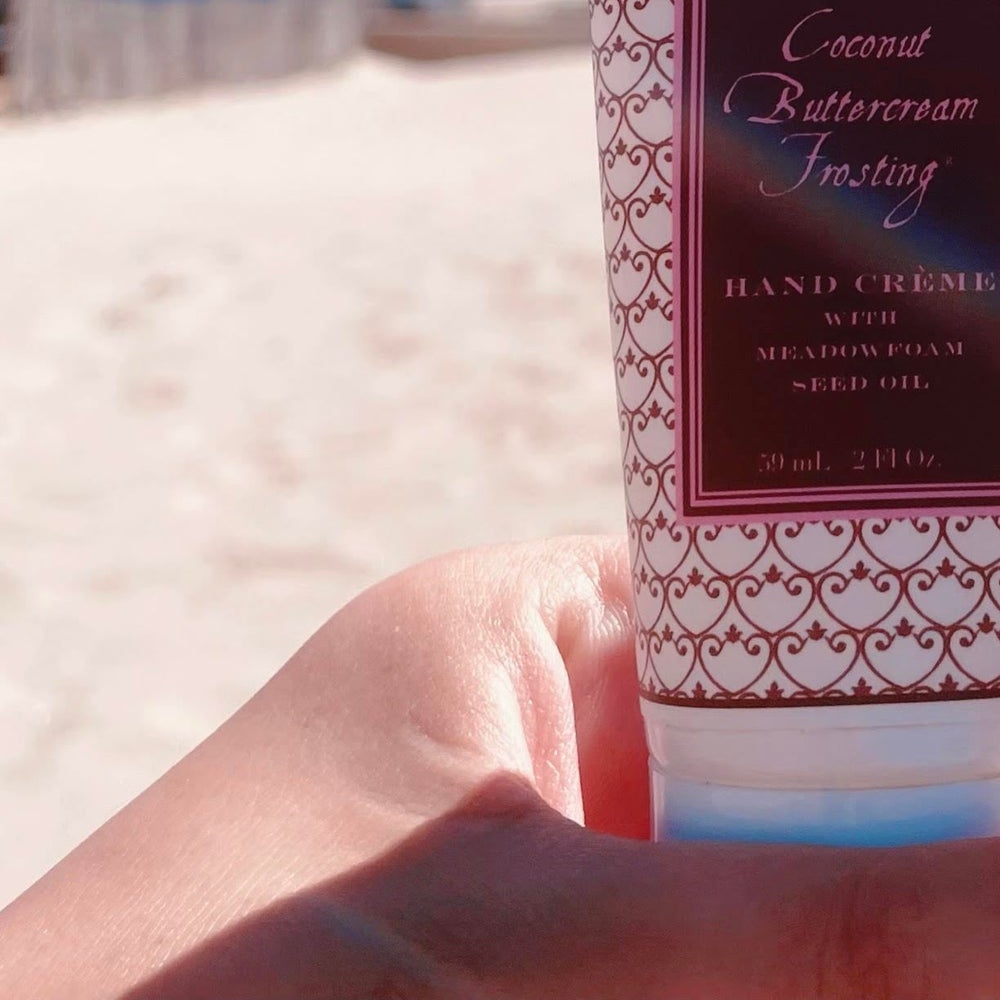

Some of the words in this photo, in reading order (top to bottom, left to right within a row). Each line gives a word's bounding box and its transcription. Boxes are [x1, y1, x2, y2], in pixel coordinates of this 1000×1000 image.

[781, 8, 932, 62] Coconut
[722, 71, 979, 125] Buttercream
[724, 274, 838, 298] HAND
[854, 264, 995, 294] CRÈME
[823, 310, 898, 326] WITH
[756, 341, 963, 361] MEADOWFOAM
[792, 376, 868, 393] SEED
[879, 374, 930, 391] OIL
[852, 451, 866, 471] 2
